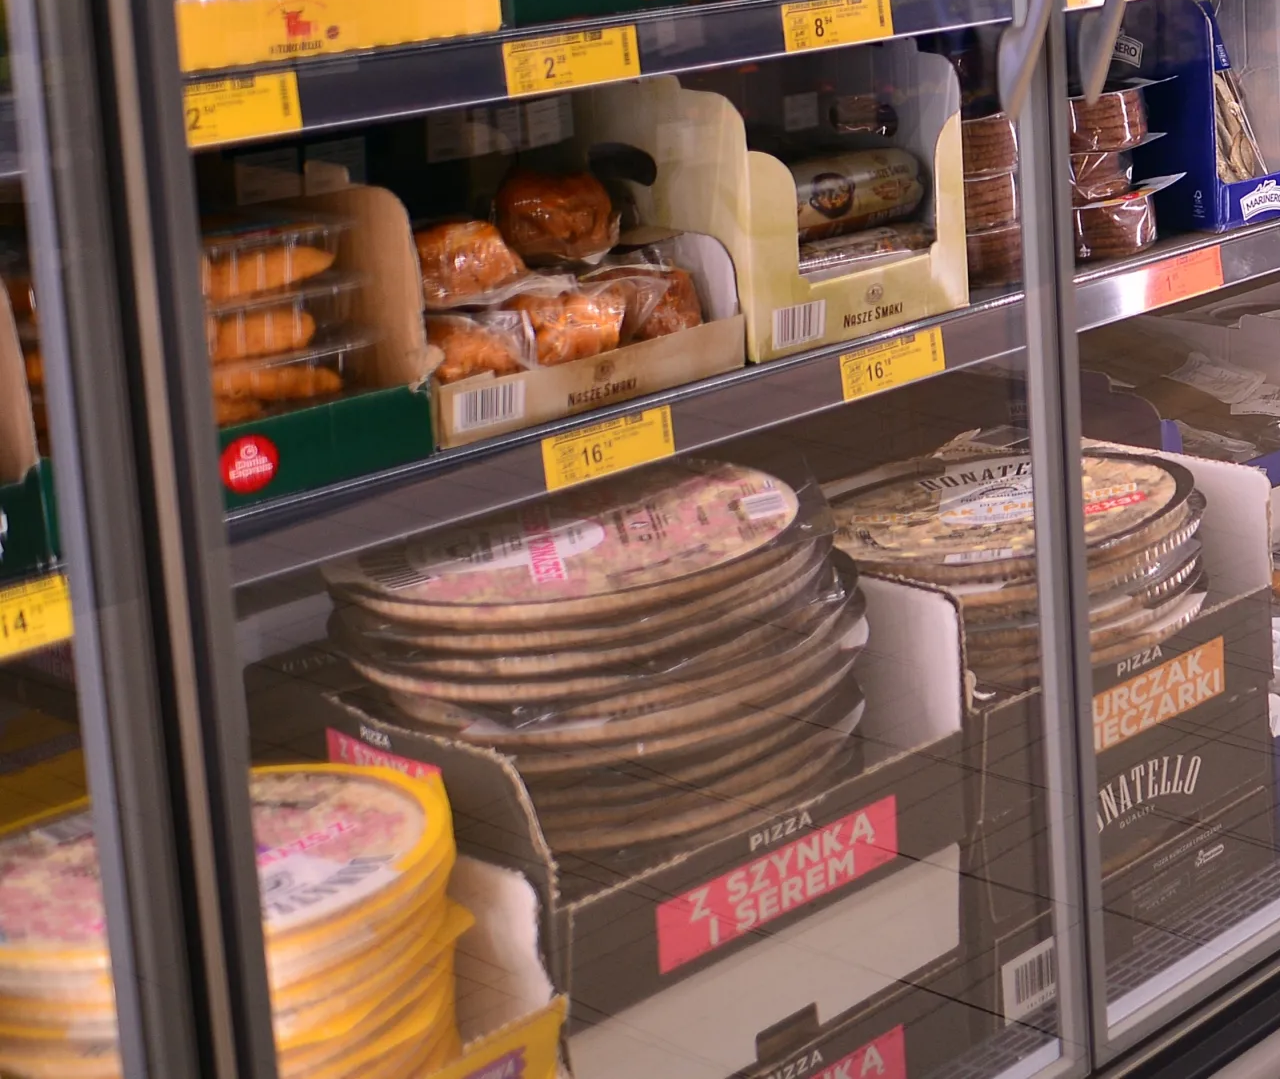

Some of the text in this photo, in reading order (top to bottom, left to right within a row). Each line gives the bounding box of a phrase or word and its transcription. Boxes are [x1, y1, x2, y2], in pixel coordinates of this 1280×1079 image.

[815, 18, 825, 37] 8
[843, 302, 904, 329] NASZE SMAKI
[866, 362, 884, 382] 16
[582, 444, 603, 467] 16
[919, 462, 1031, 492] DONATE
[1116, 646, 1163, 677] PIZZA
[1093, 648, 1205, 722] URCZAK
[1094, 670, 1222, 751] IECZARKI
[1097, 753, 1202, 831] NATELLO
[748, 811, 813, 852] PIZZA
[688, 810, 877, 923] Z SZYNKĄ
[707, 849, 857, 947] I SEREM
